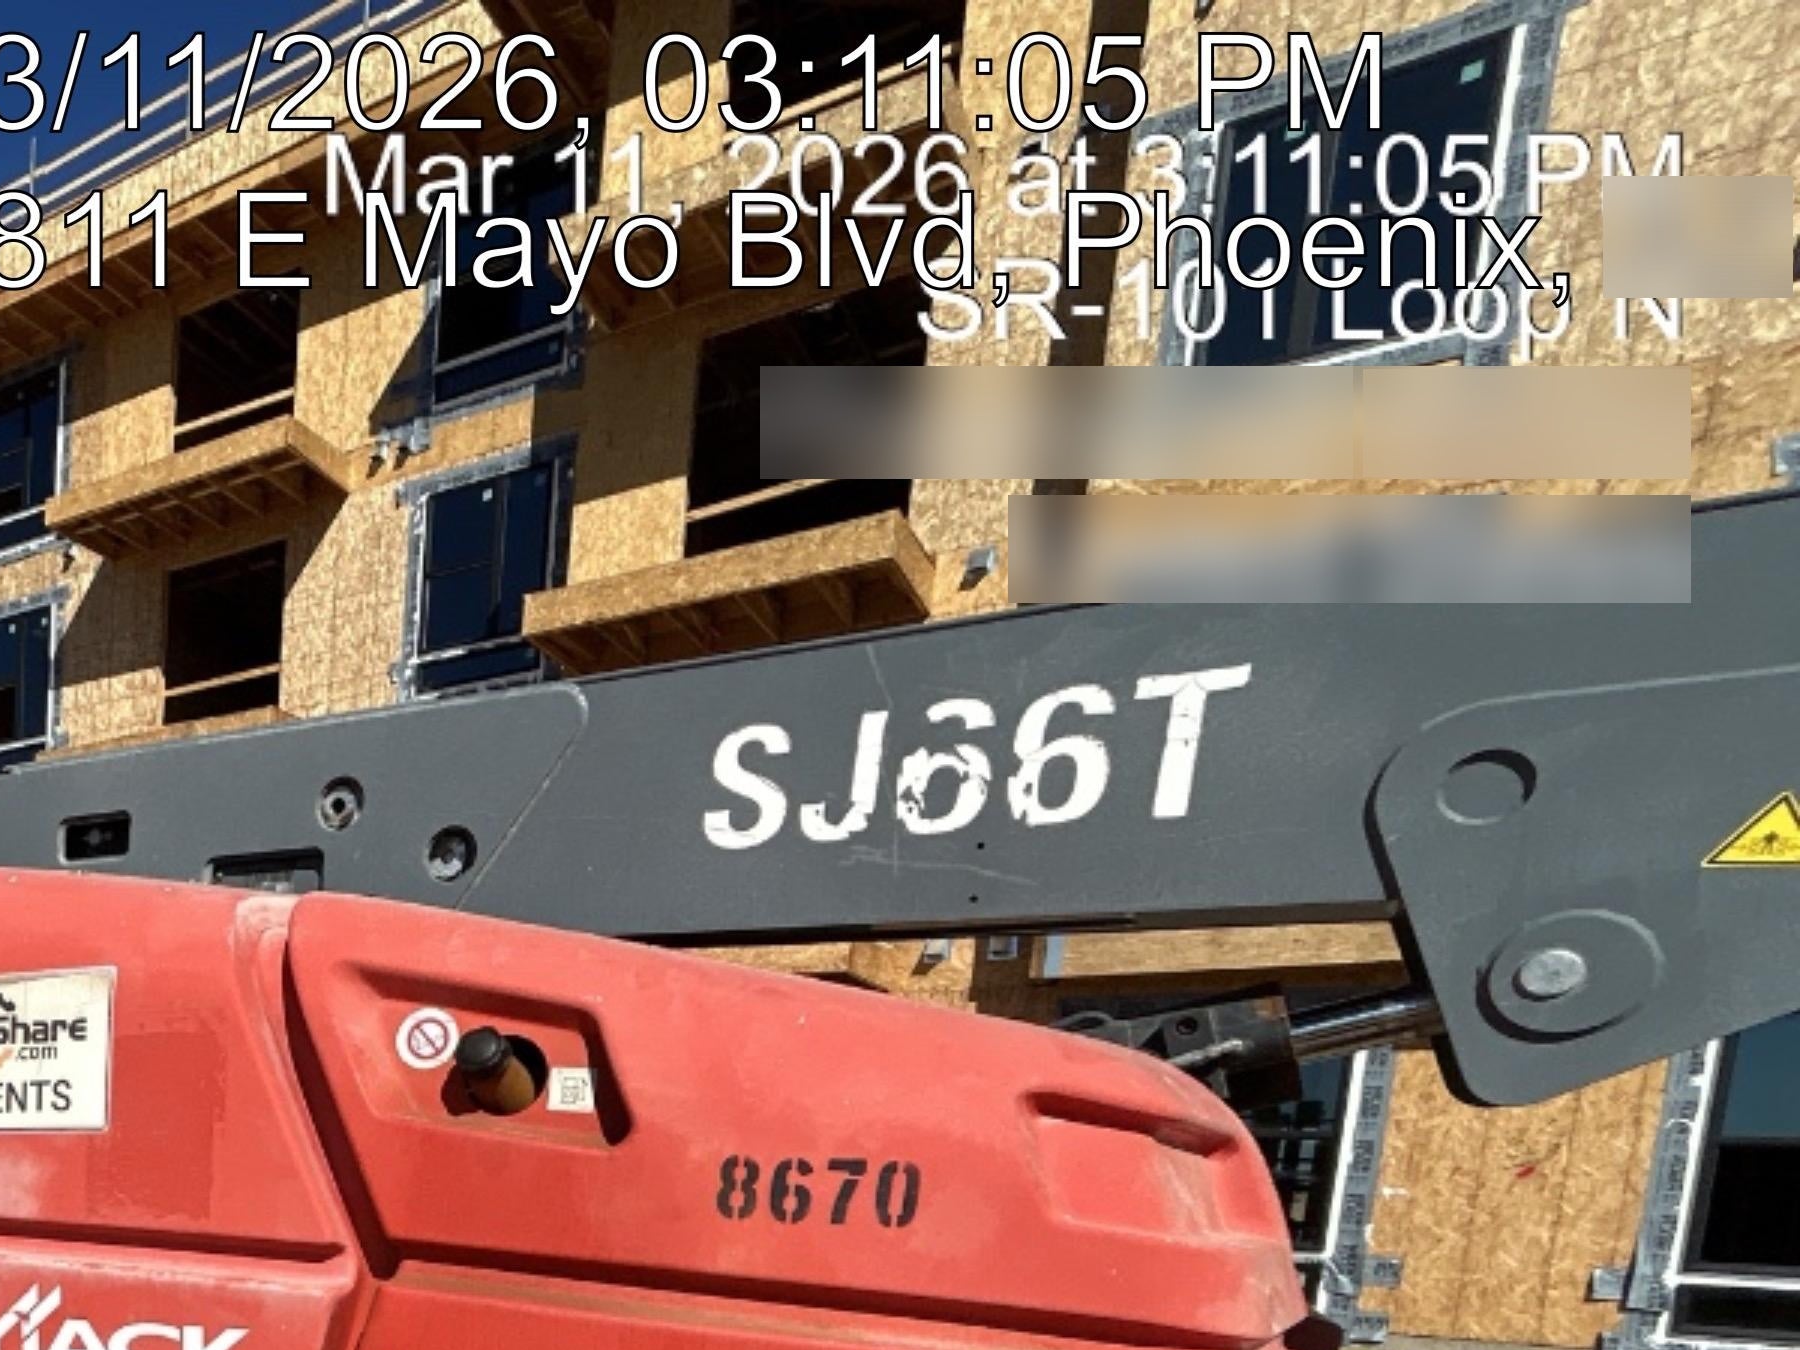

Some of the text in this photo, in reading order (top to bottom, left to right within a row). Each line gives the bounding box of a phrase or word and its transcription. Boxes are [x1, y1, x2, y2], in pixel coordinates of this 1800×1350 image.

[703, 662, 1253, 850] SJ66T
[15, 1045, 59, 1061] .com
[716, 1154, 922, 1228] 8670
